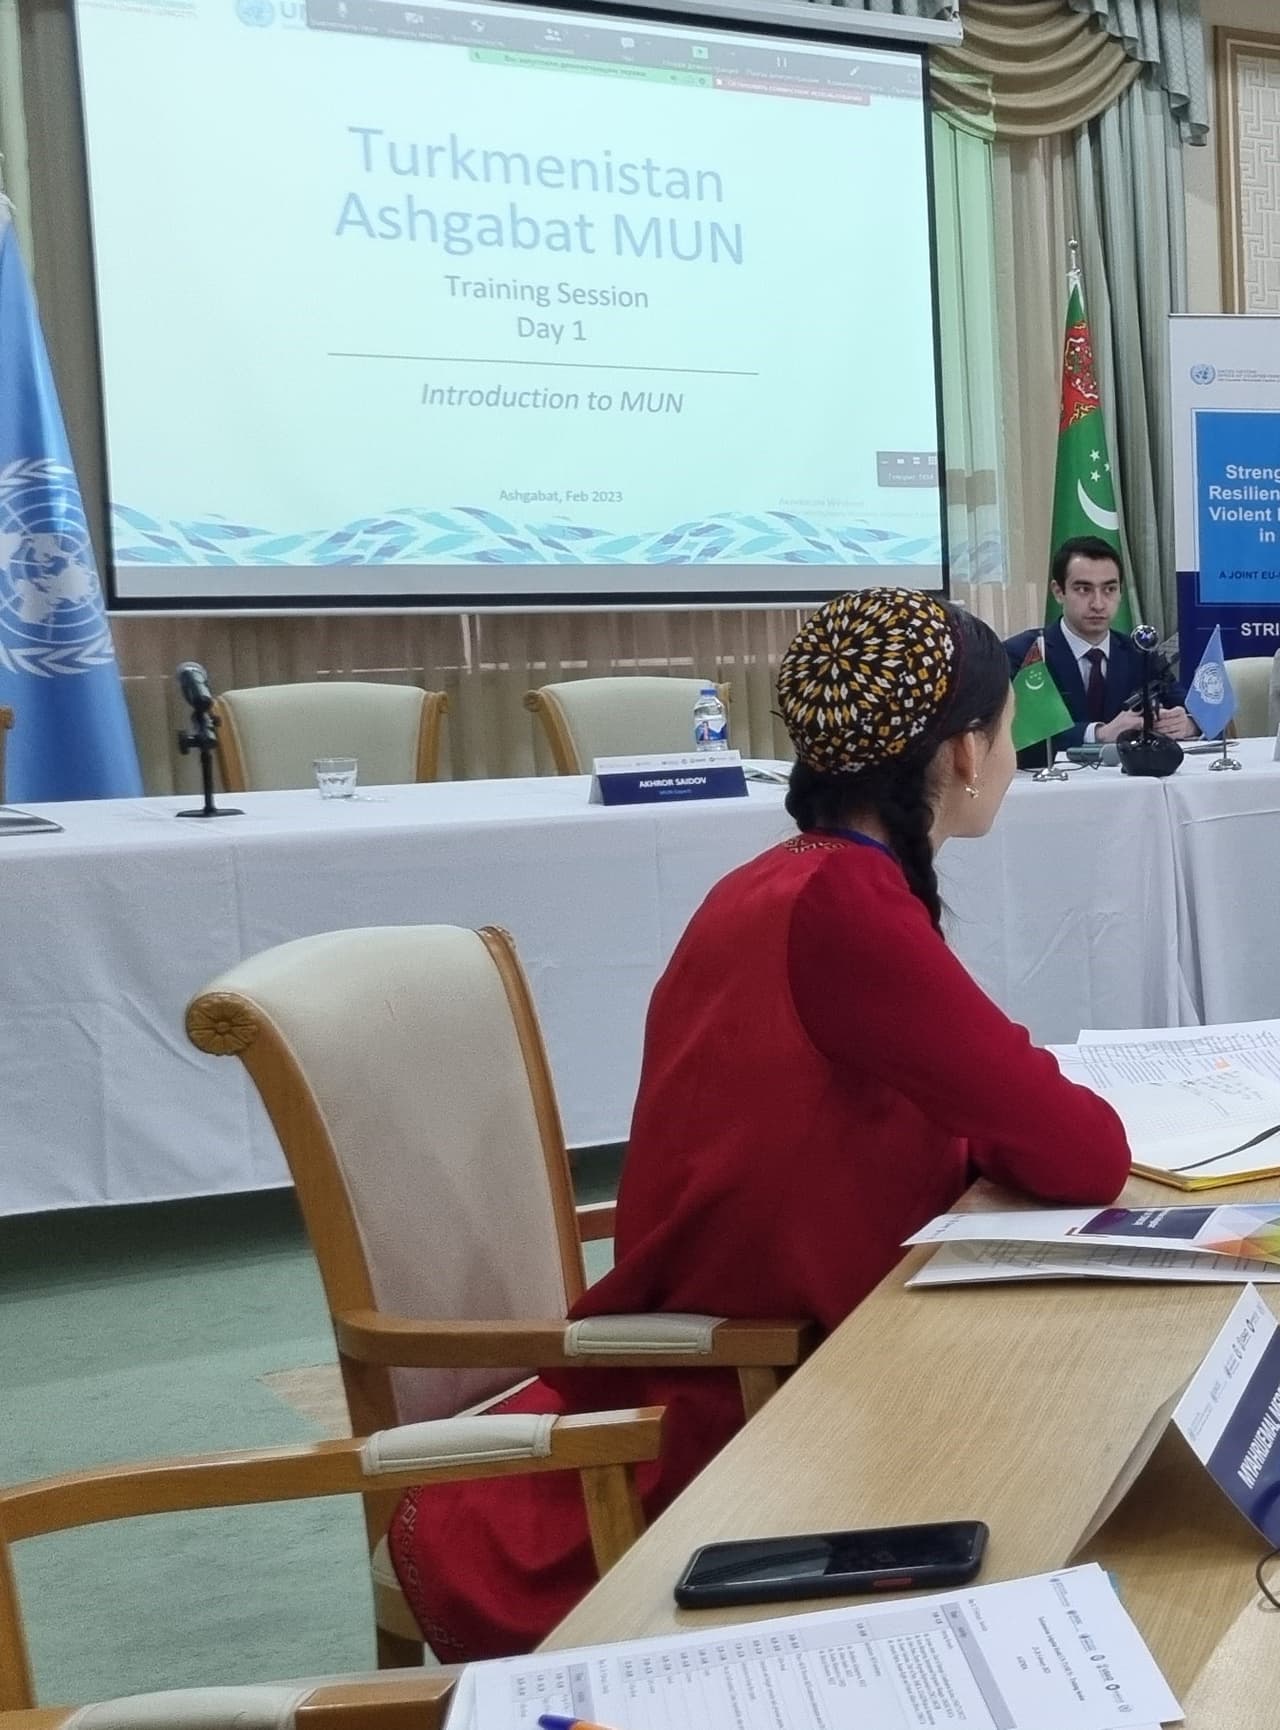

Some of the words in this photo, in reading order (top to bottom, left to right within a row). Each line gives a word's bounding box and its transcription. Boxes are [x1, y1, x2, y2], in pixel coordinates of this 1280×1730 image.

[348, 126, 725, 203] Turkmenistan
[334, 193, 597, 257] Ashgabat
[613, 212, 745, 266] MUN
[445, 274, 550, 308] Training
[557, 279, 649, 309] Session
[516, 316, 563, 345] Day
[571, 320, 587, 341] 1
[421, 383, 579, 411] Introduction
[586, 388, 613, 412] to
[620, 392, 684, 414] MUN
[499, 488, 562, 505] Ashgabat,
[565, 489, 591, 502] Feb
[592, 490, 624, 503] 2023
[1209, 507, 1272, 522] Violent
[1259, 528, 1275, 543] in
[1219, 571, 1227, 579] A
[1229, 571, 1258, 580] JOINT
[675, 776, 706, 786] SAIDOV
